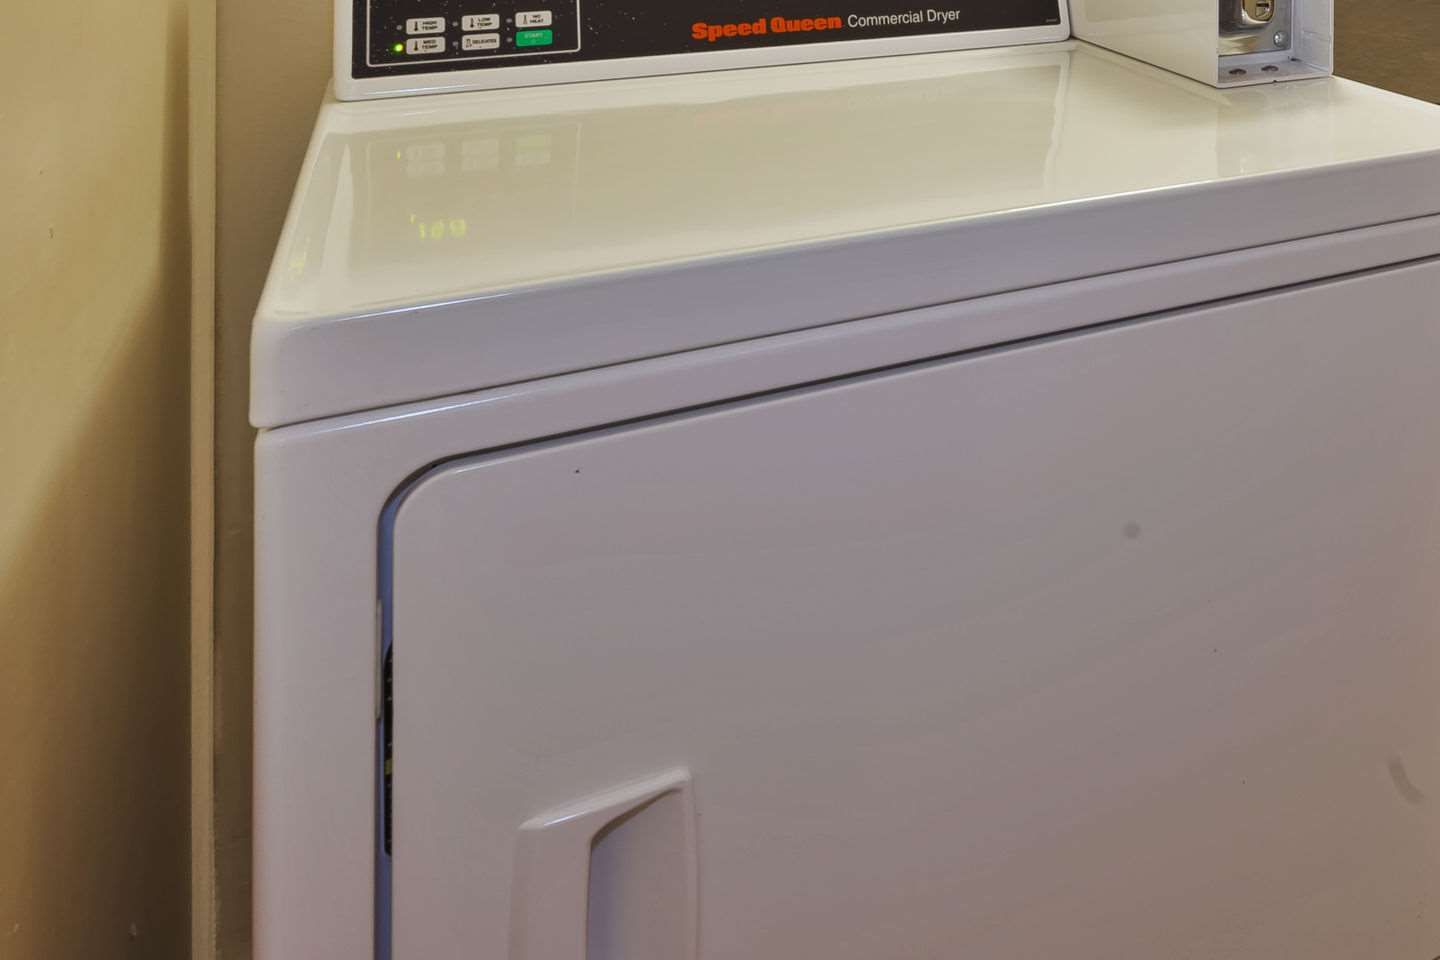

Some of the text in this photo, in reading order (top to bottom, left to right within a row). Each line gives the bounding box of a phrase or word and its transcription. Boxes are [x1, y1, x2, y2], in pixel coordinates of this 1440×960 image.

[691, 8, 961, 41] Speed Queen Commercial Dryer
